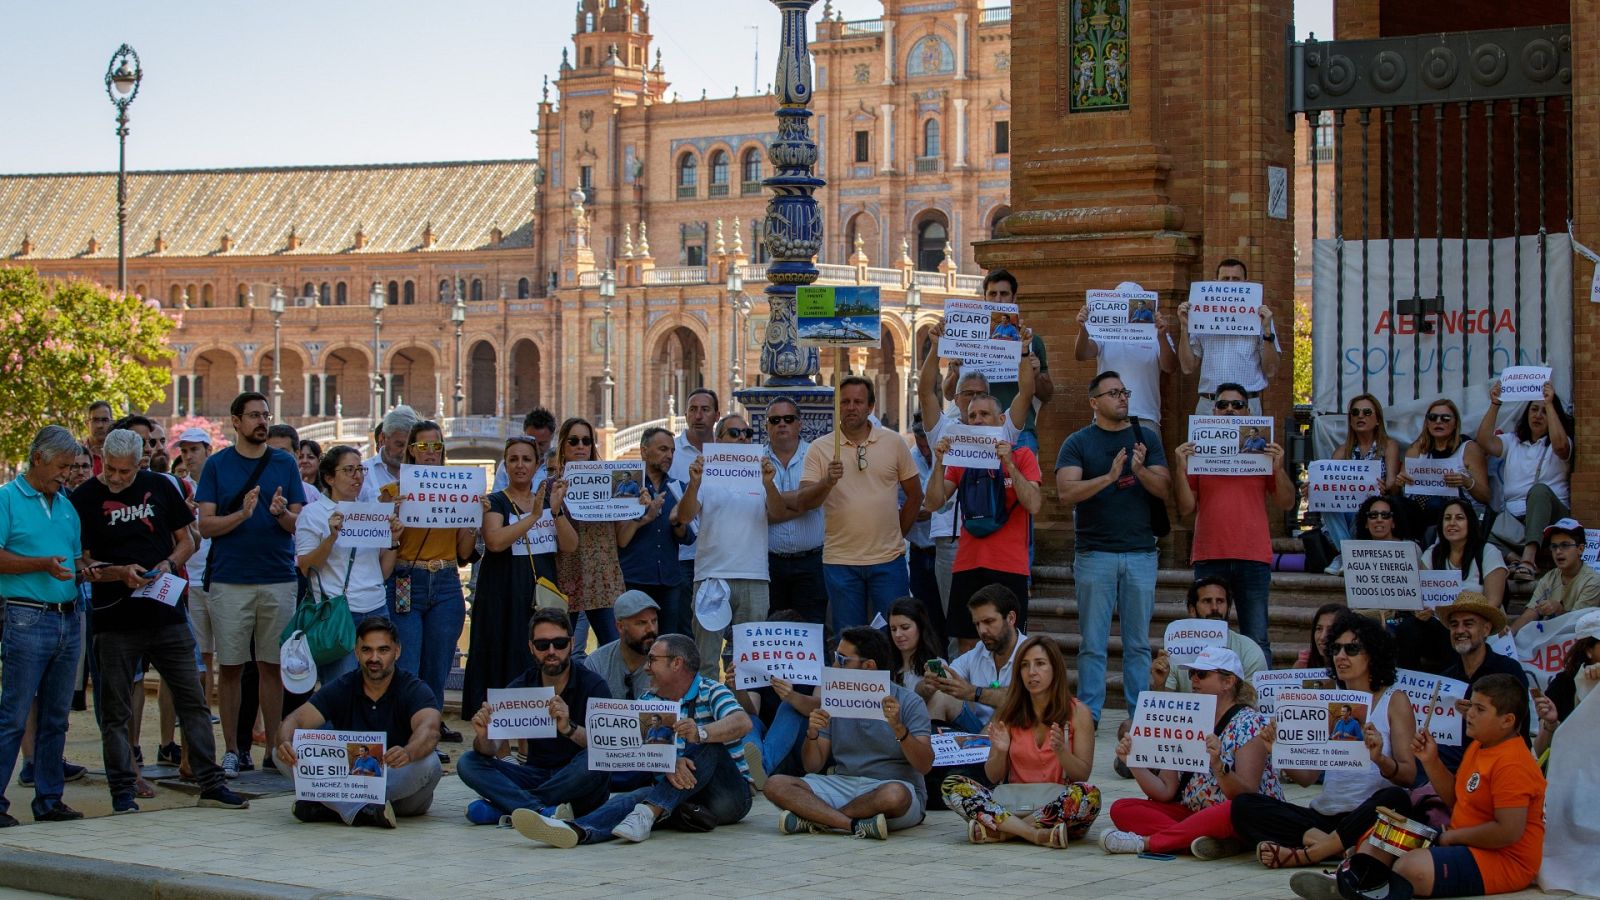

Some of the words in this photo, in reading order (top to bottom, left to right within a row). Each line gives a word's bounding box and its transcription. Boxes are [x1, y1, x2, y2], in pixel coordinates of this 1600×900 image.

[1201, 285, 1251, 294] SÁNCHEZ
[1090, 303, 1127, 311] ¡¡CLARO
[1194, 305, 1255, 313] ABENGOA
[946, 314, 989, 324] ¡¡CLARO
[1090, 316, 1109, 324] QUE
[1112, 316, 1126, 324] SI!!
[1374, 308, 1516, 335] ABENGOA
[946, 329, 968, 337] QUE
[971, 330, 987, 339] SI!!
[1344, 340, 1539, 376] SOLUCIÓN
[1193, 430, 1237, 440] ¡¡CLARO
[1195, 446, 1216, 454] QUE
[1220, 446, 1236, 454] SI!!
[707, 454, 759, 463] ¡¡ABENGOA
[706, 467, 760, 477] SOLUCIÓN!!
[1320, 463, 1369, 472] SÁNCHEZ
[414, 469, 473, 480] SÁNCHEZ
[407, 493, 479, 503] ABENGOA
[567, 491, 589, 500] QUE
[593, 491, 609, 500] SI!!
[111, 504, 155, 525] PUMA
[341, 528, 389, 538] SOLUCIÓN!!
[1352, 550, 1392, 558] EMPRESAS
[1347, 562, 1371, 570] AGUA
[1380, 562, 1413, 571] ENERGÍA
[1356, 575, 1368, 583] NO
[1371, 575, 1379, 583] SE
[1381, 576, 1407, 584] CREAN
[1381, 588, 1395, 596] LOS
[1397, 587, 1416, 597] DÍAS
[746, 627, 808, 637] SÁNCHEZ
[1168, 631, 1223, 641] ¡¡ABENGOA
[741, 651, 817, 662] ABENGOA
[767, 663, 793, 671] ESTÁ
[783, 673, 817, 681] LUCHA
[825, 681, 885, 692] ¡¡ABENGOA
[1277, 693, 1317, 701] ¡¡ABENGOA
[1319, 693, 1367, 703] SOLUCIÓN!!
[825, 698, 880, 709] SOLUCIÓN
[1143, 697, 1200, 711] SÁNCHEZ
[1146, 714, 1193, 723] ESCUCHA
[1276, 709, 1326, 722] ¡¡CLARO
[493, 716, 553, 727] SOLUCIÓN!!
[591, 717, 637, 729] ¡¡CLARO
[298, 733, 336, 741] ¡¡ABENGOA
[338, 734, 381, 742] SOLUCIÓN!!
[1133, 726, 1205, 741] ABENGOA
[1278, 730, 1303, 741] QUE
[1307, 730, 1326, 741] SI!!
[594, 735, 617, 746] QUE
[621, 737, 640, 746] SI!!
[297, 747, 345, 759] ¡¡CLARO
[1158, 744, 1183, 753] ESTÁ
[1173, 757, 1204, 766] LUCHA
[300, 765, 324, 776] QUE
[328, 766, 346, 776] SI!!
